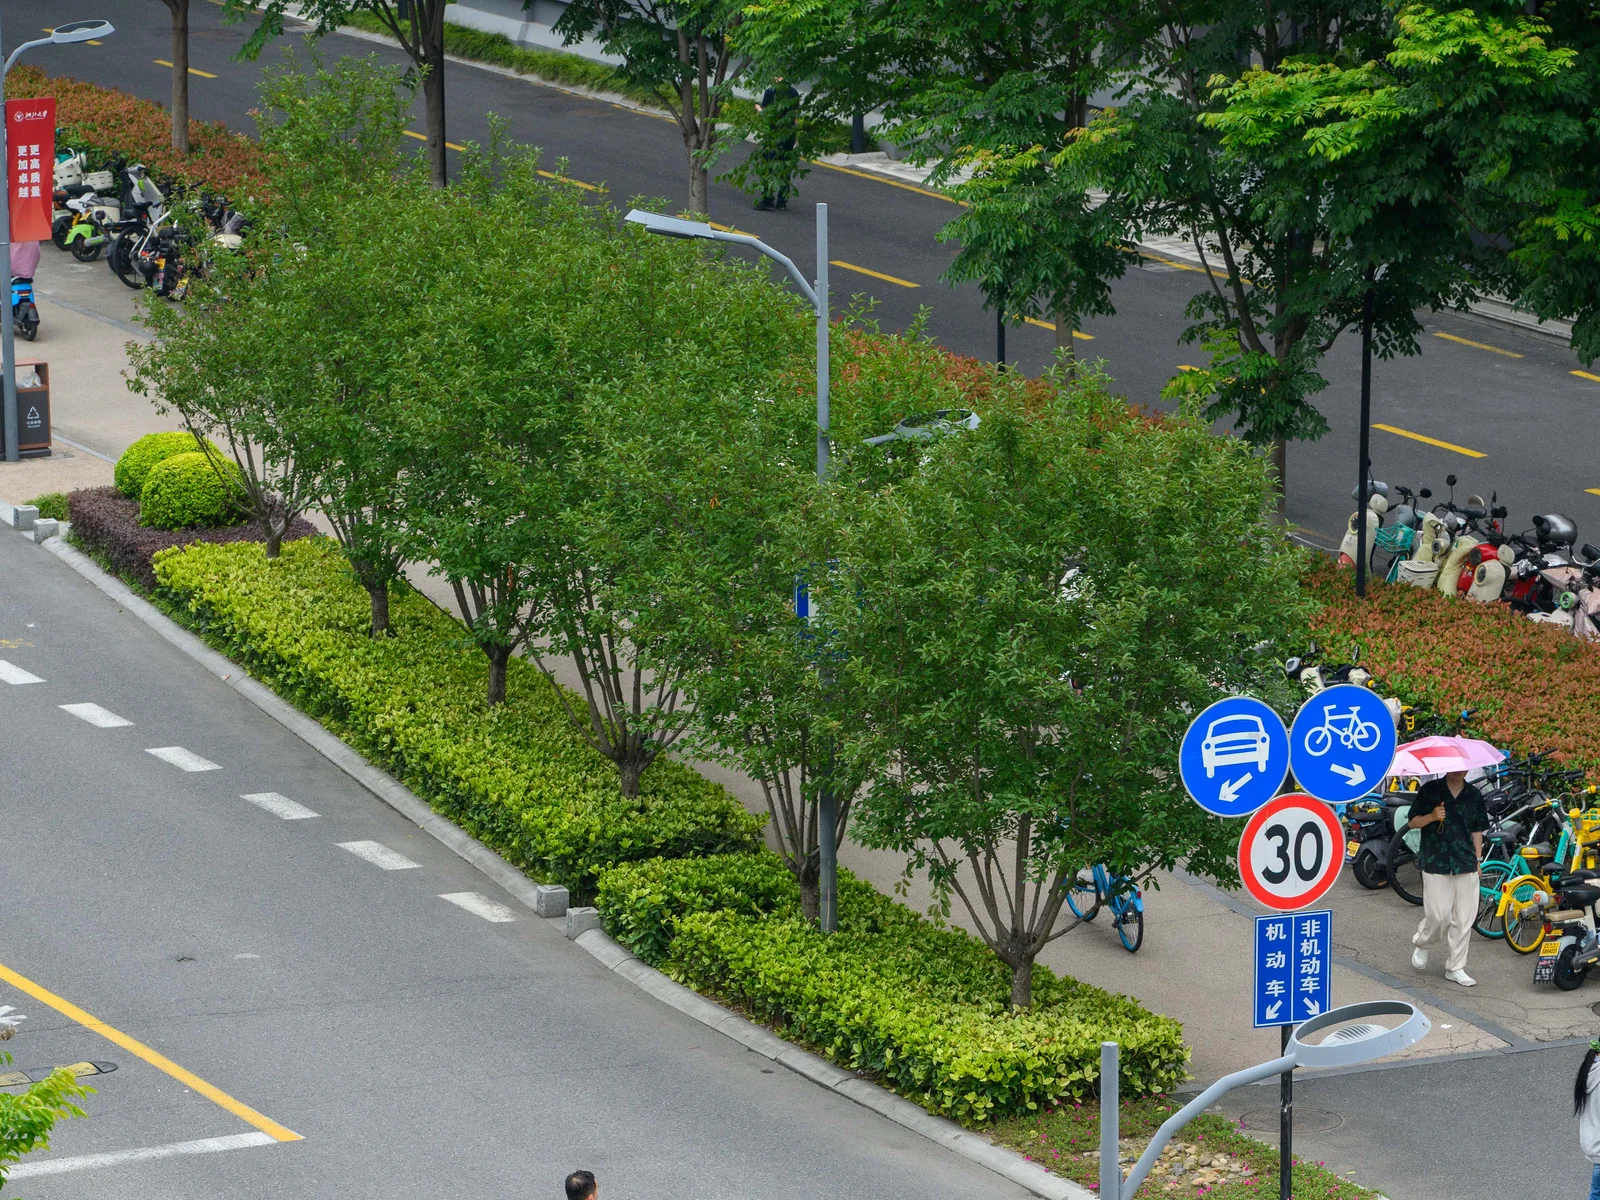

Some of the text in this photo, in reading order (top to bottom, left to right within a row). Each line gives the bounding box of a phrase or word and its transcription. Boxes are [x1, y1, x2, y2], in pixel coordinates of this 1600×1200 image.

[17, 145, 29, 198] 更加卓越
[30, 144, 41, 198] 更高质量
[1261, 820, 1324, 885] 30
[1265, 922, 1287, 997] 机动车
[1300, 919, 1322, 994] 非机动车
